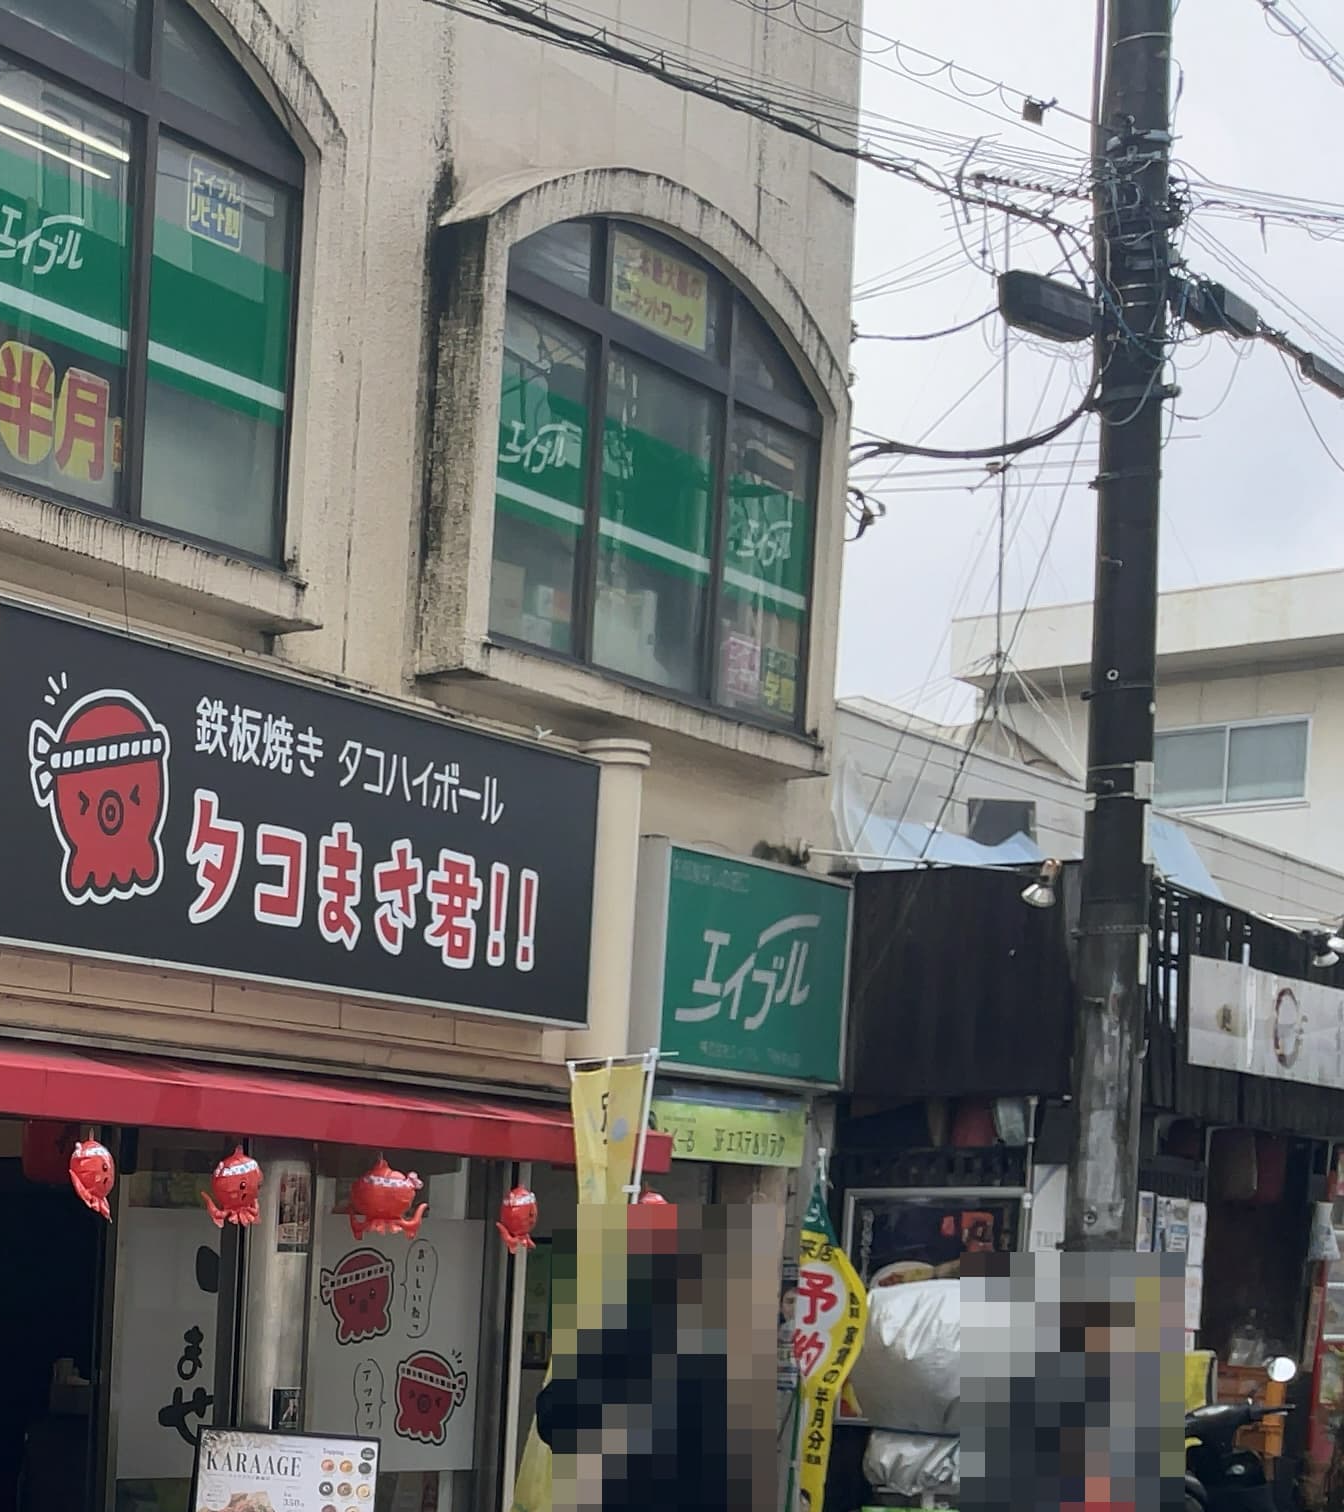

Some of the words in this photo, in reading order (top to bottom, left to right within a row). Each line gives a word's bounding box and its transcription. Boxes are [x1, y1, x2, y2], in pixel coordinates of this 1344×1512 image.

[498, 420, 582, 473] エイブル
[194, 696, 324, 778] 鉄板焼き
[338, 739, 504, 824] タコハイボール
[674, 914, 821, 1030] エイブル
[791, 1271, 837, 1377] 予約
[207, 1451, 302, 1477] KARAAGE
